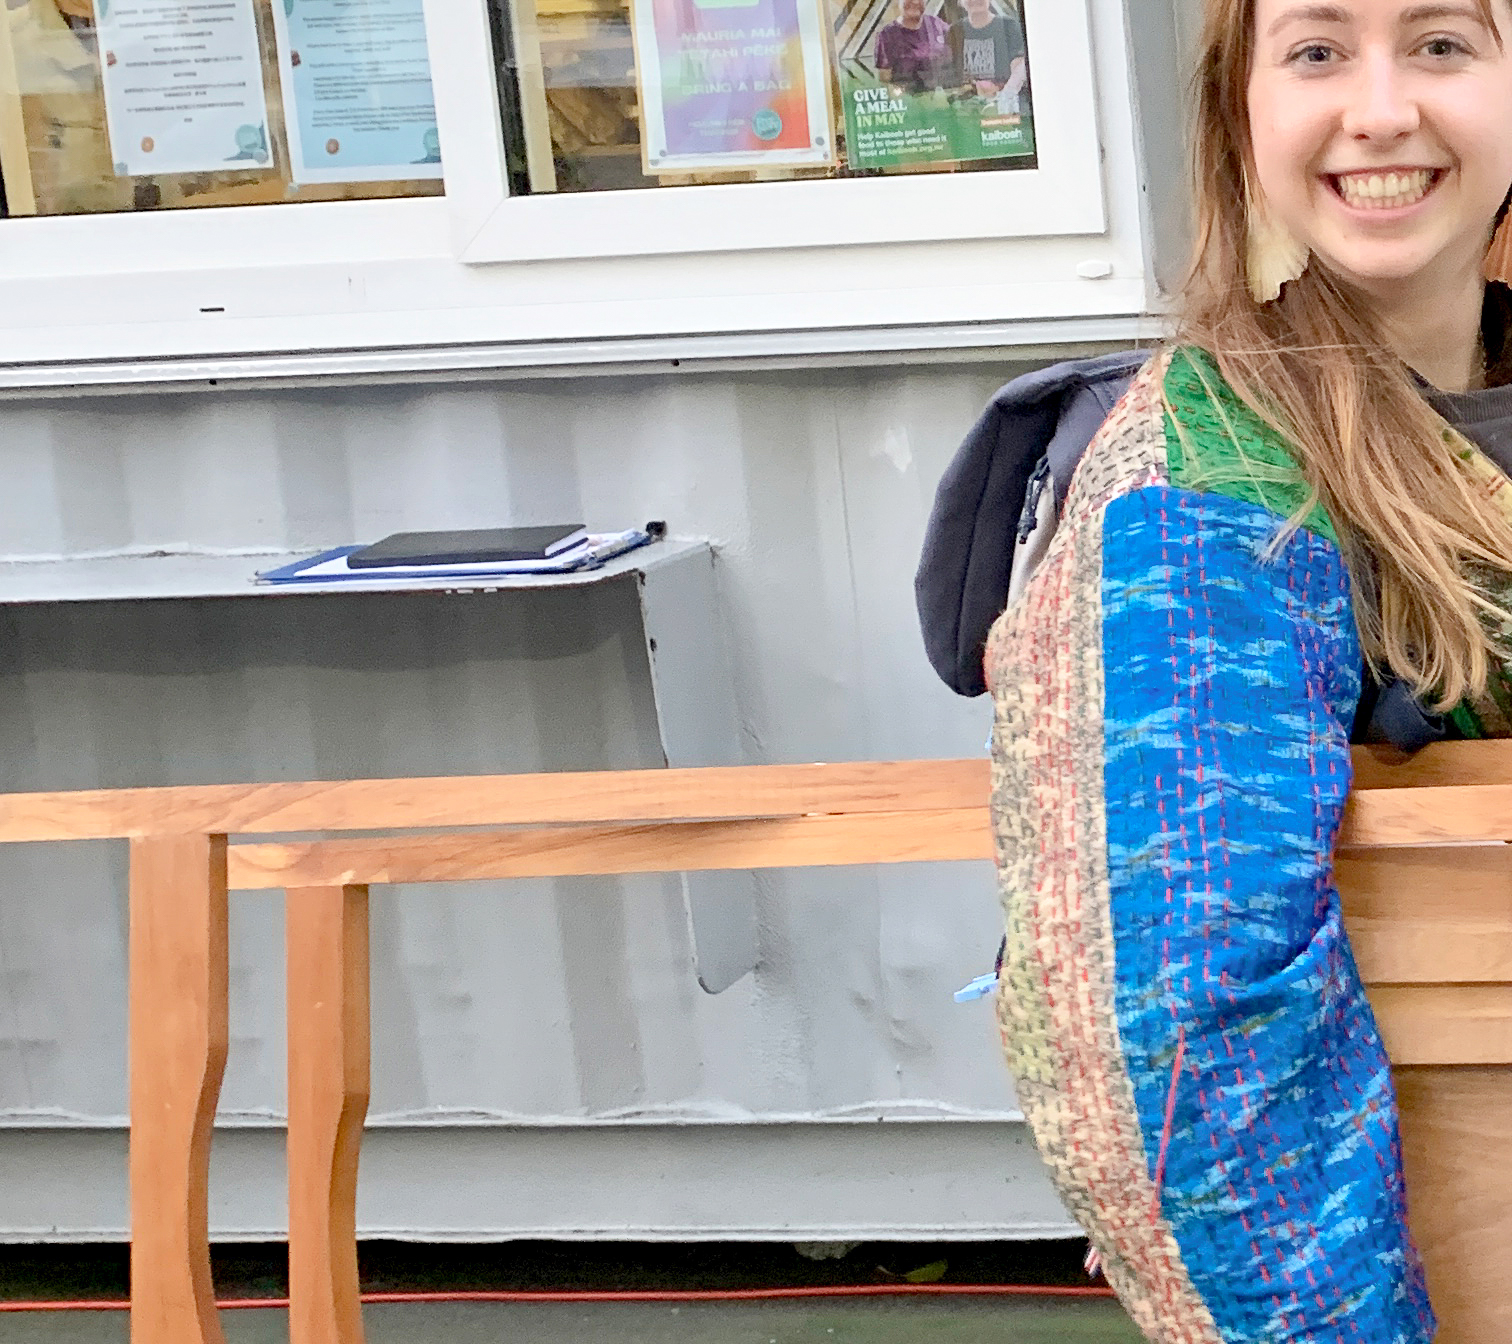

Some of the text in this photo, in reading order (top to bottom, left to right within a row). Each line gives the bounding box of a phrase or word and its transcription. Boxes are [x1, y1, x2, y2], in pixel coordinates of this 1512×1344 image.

[681, 27, 781, 42] MAURIA MAI
[682, 79, 793, 96] BRING A BAG
[853, 87, 889, 103] GIVE
[855, 99, 907, 115] A MEAL
[856, 112, 906, 128] IN MAY
[980, 128, 1022, 142] kaibosh
